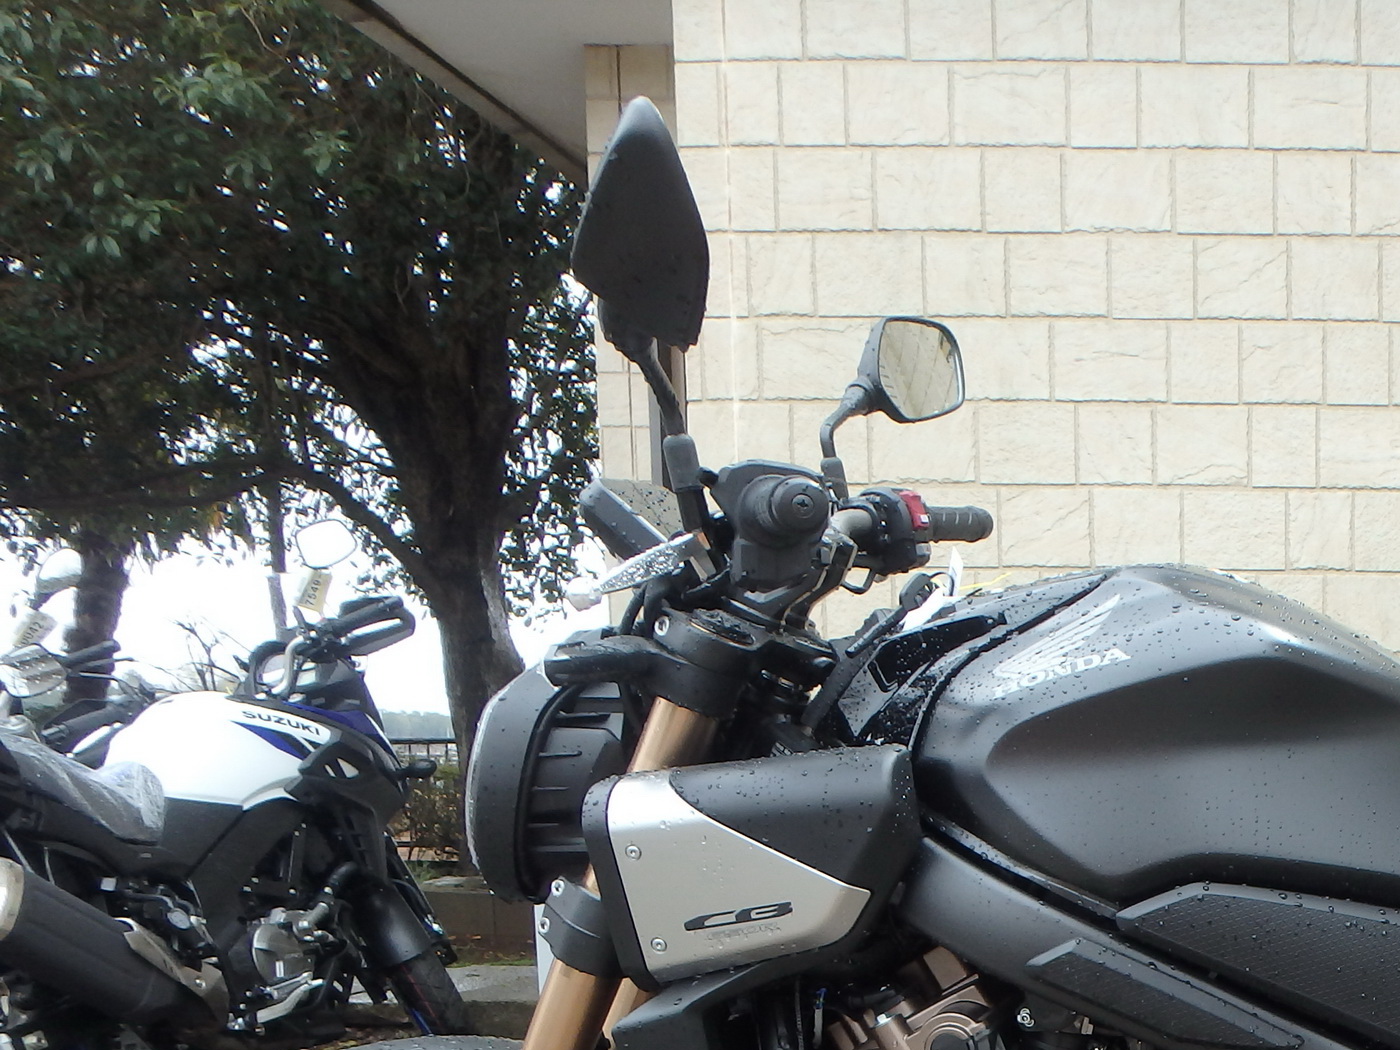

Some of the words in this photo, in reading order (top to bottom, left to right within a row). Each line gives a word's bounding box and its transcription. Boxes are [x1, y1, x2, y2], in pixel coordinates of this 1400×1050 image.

[992, 648, 1132, 699] HONDA
[242, 710, 321, 736] SUZUKI
[684, 901, 793, 931] CB
